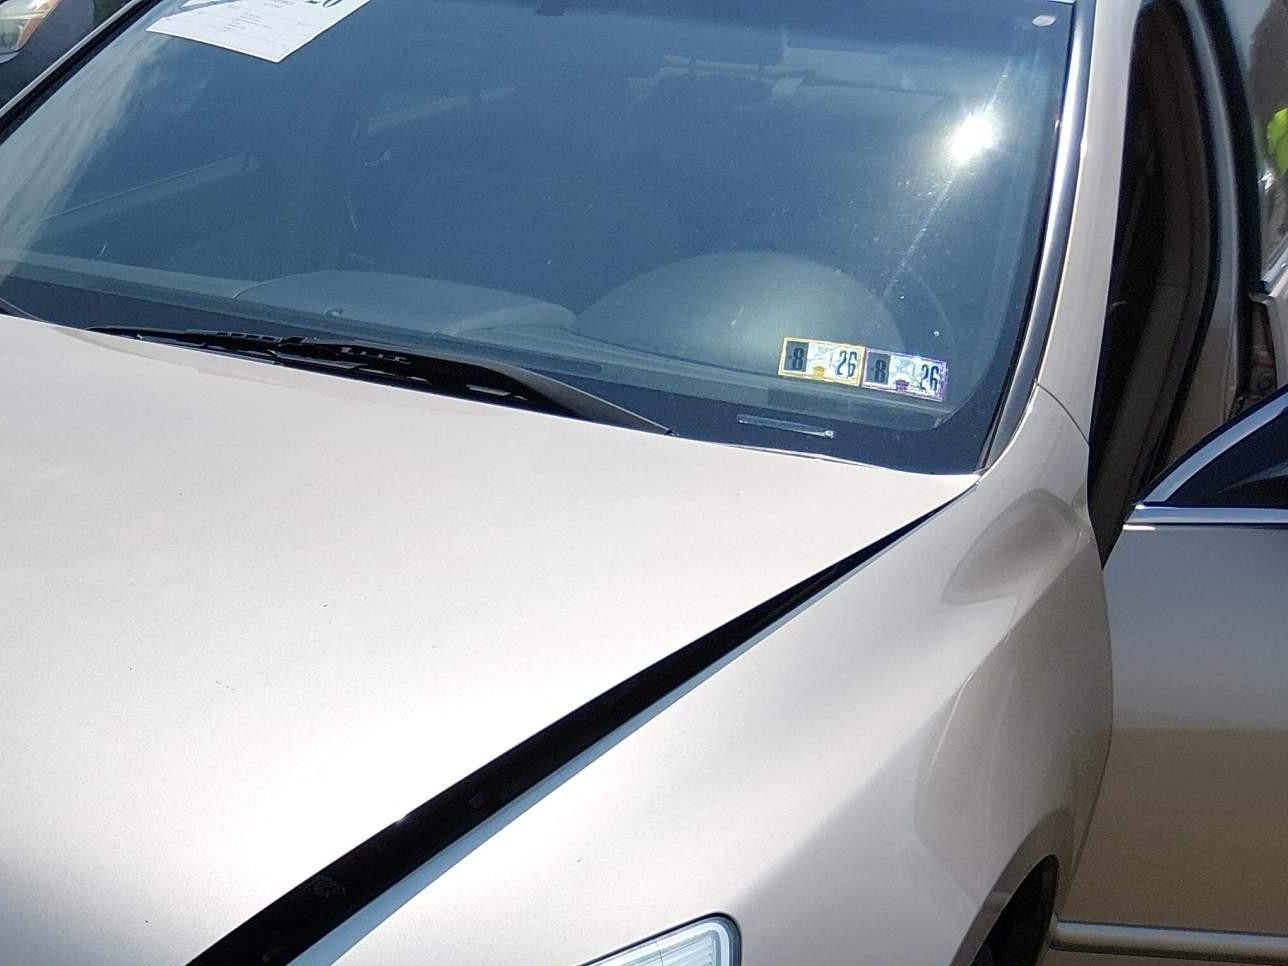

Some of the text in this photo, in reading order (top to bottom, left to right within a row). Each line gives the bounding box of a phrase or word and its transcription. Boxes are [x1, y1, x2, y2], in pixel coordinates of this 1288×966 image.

[792, 347, 858, 378] 8 26
[874, 359, 940, 392] 8 26
